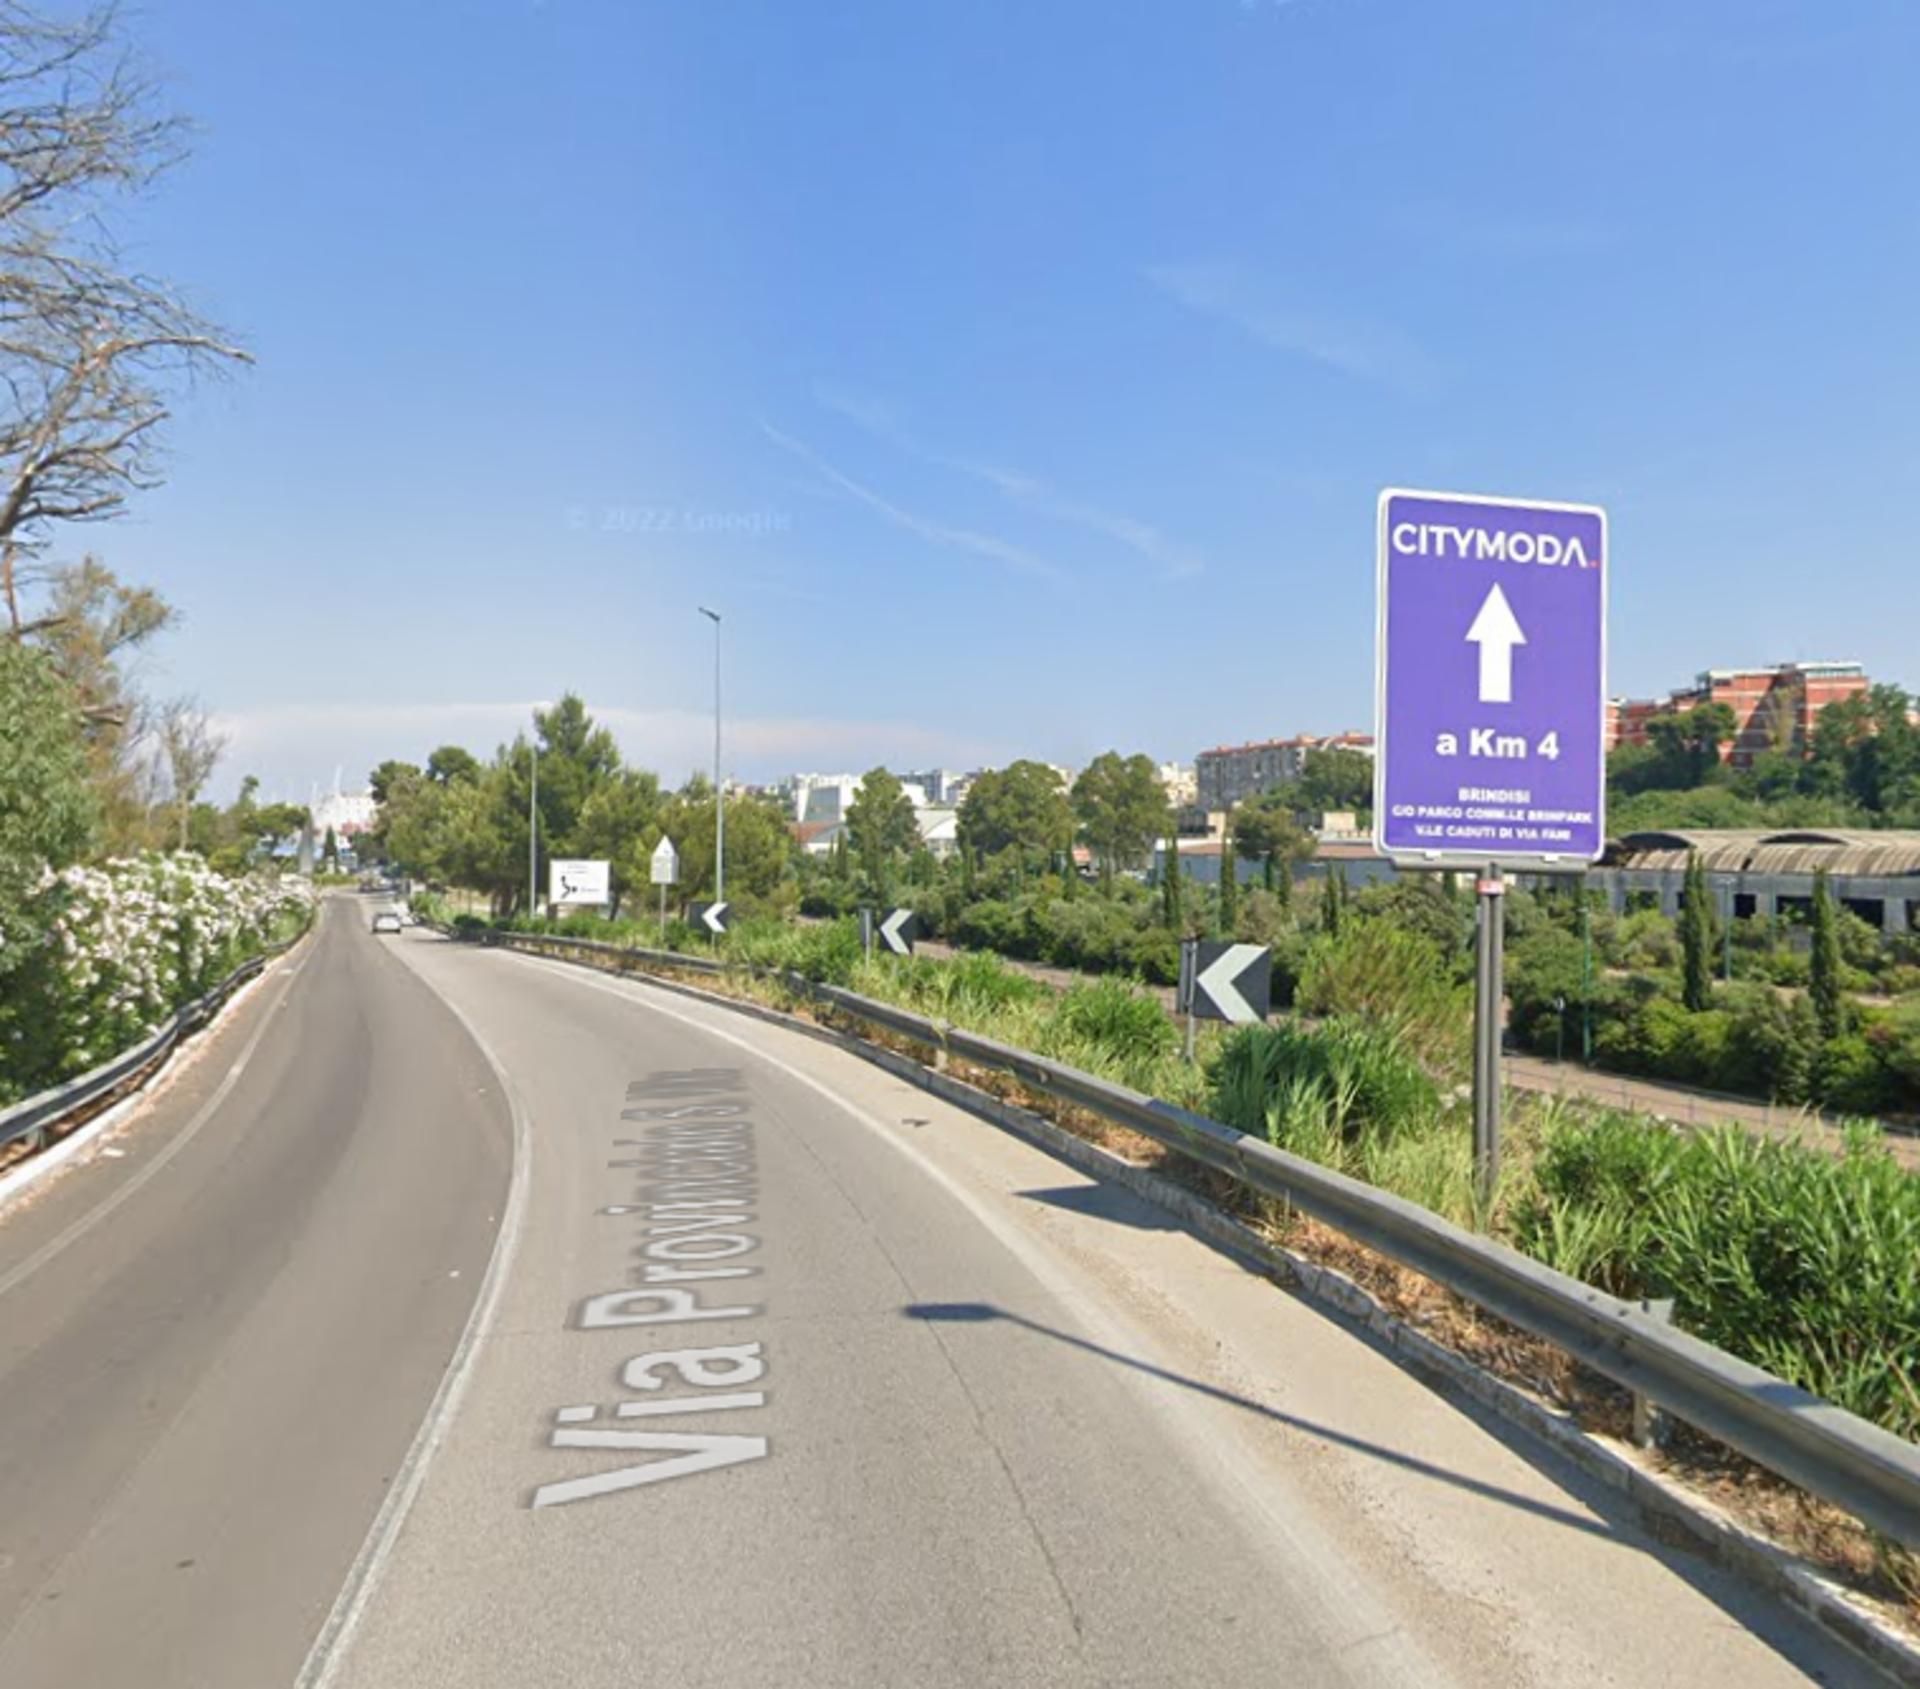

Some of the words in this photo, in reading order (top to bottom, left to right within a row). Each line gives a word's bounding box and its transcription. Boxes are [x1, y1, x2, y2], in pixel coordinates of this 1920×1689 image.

[1436, 732, 1457, 756] a
[1469, 728, 1526, 758] Km
[1537, 731, 1560, 760] 4
[1458, 787, 1530, 804] BRINDISI
[1418, 805, 1462, 819] PARCO
[1446, 825, 1495, 839] CADUTI
[1499, 827, 1513, 840] DI
[1517, 828, 1538, 841] VIA
